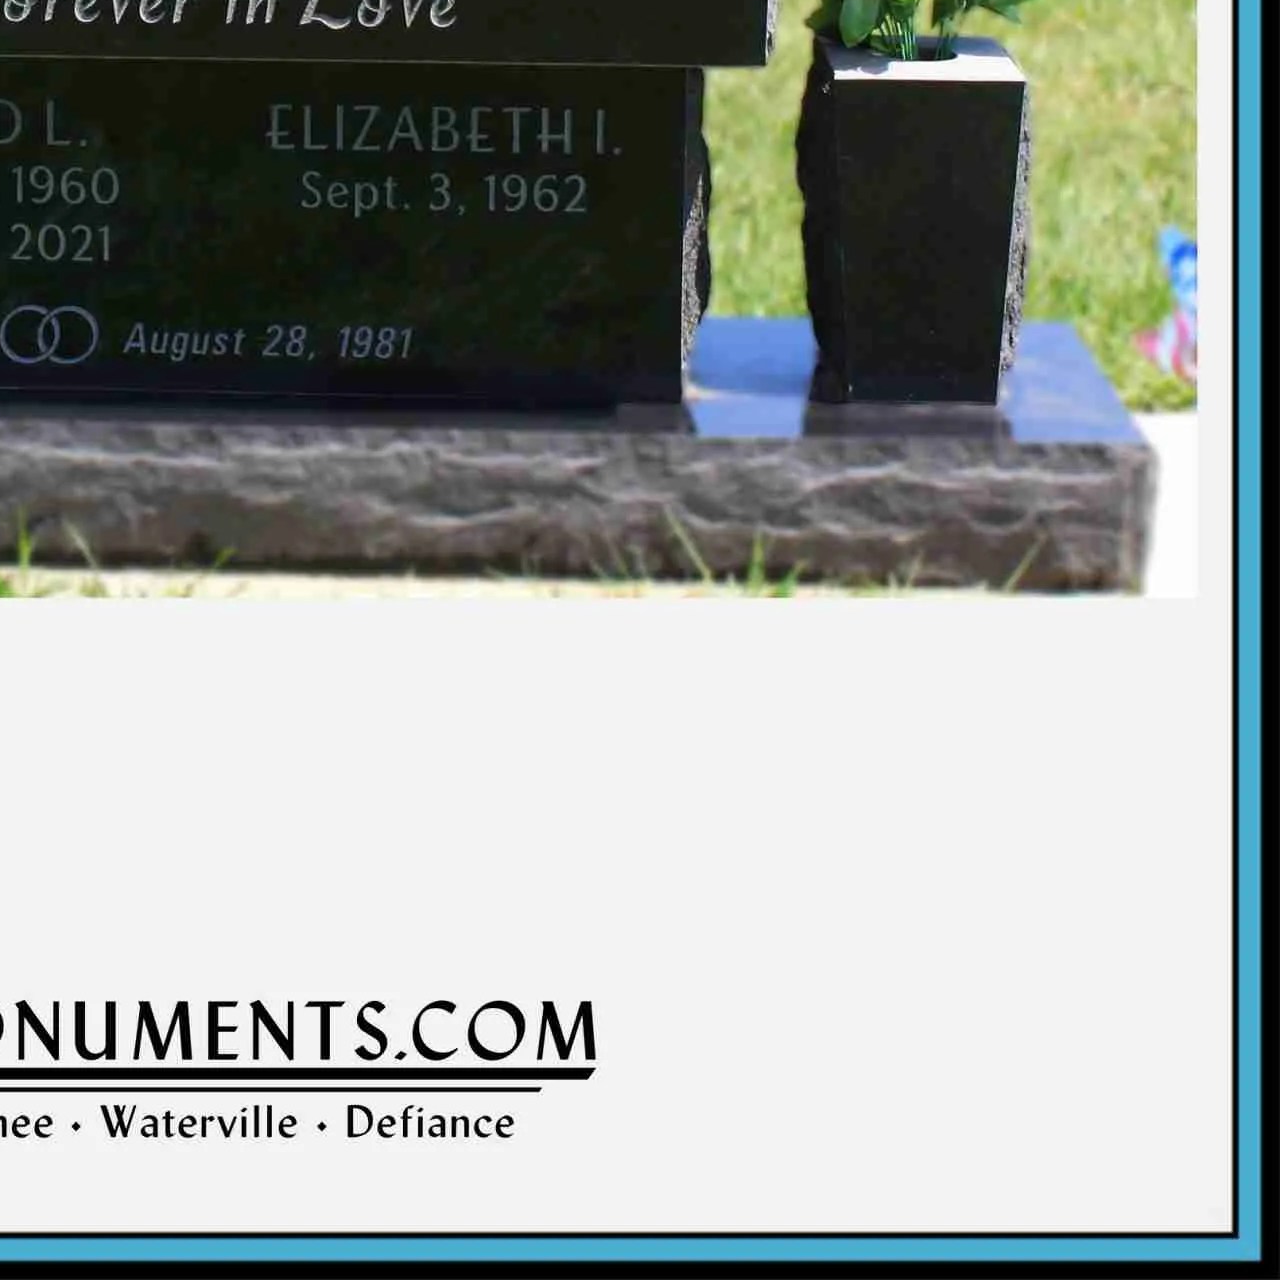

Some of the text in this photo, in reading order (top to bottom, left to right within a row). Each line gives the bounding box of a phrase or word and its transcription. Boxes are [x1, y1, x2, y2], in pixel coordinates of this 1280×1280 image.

[46, 100, 88, 147] L.
[265, 104, 622, 155] ELIZABETH I.
[12, 165, 120, 205] 1960
[300, 171, 587, 218] Sept. 3, 1962
[10, 223, 111, 262] 2021
[122, 323, 413, 362] August 28, 1981
